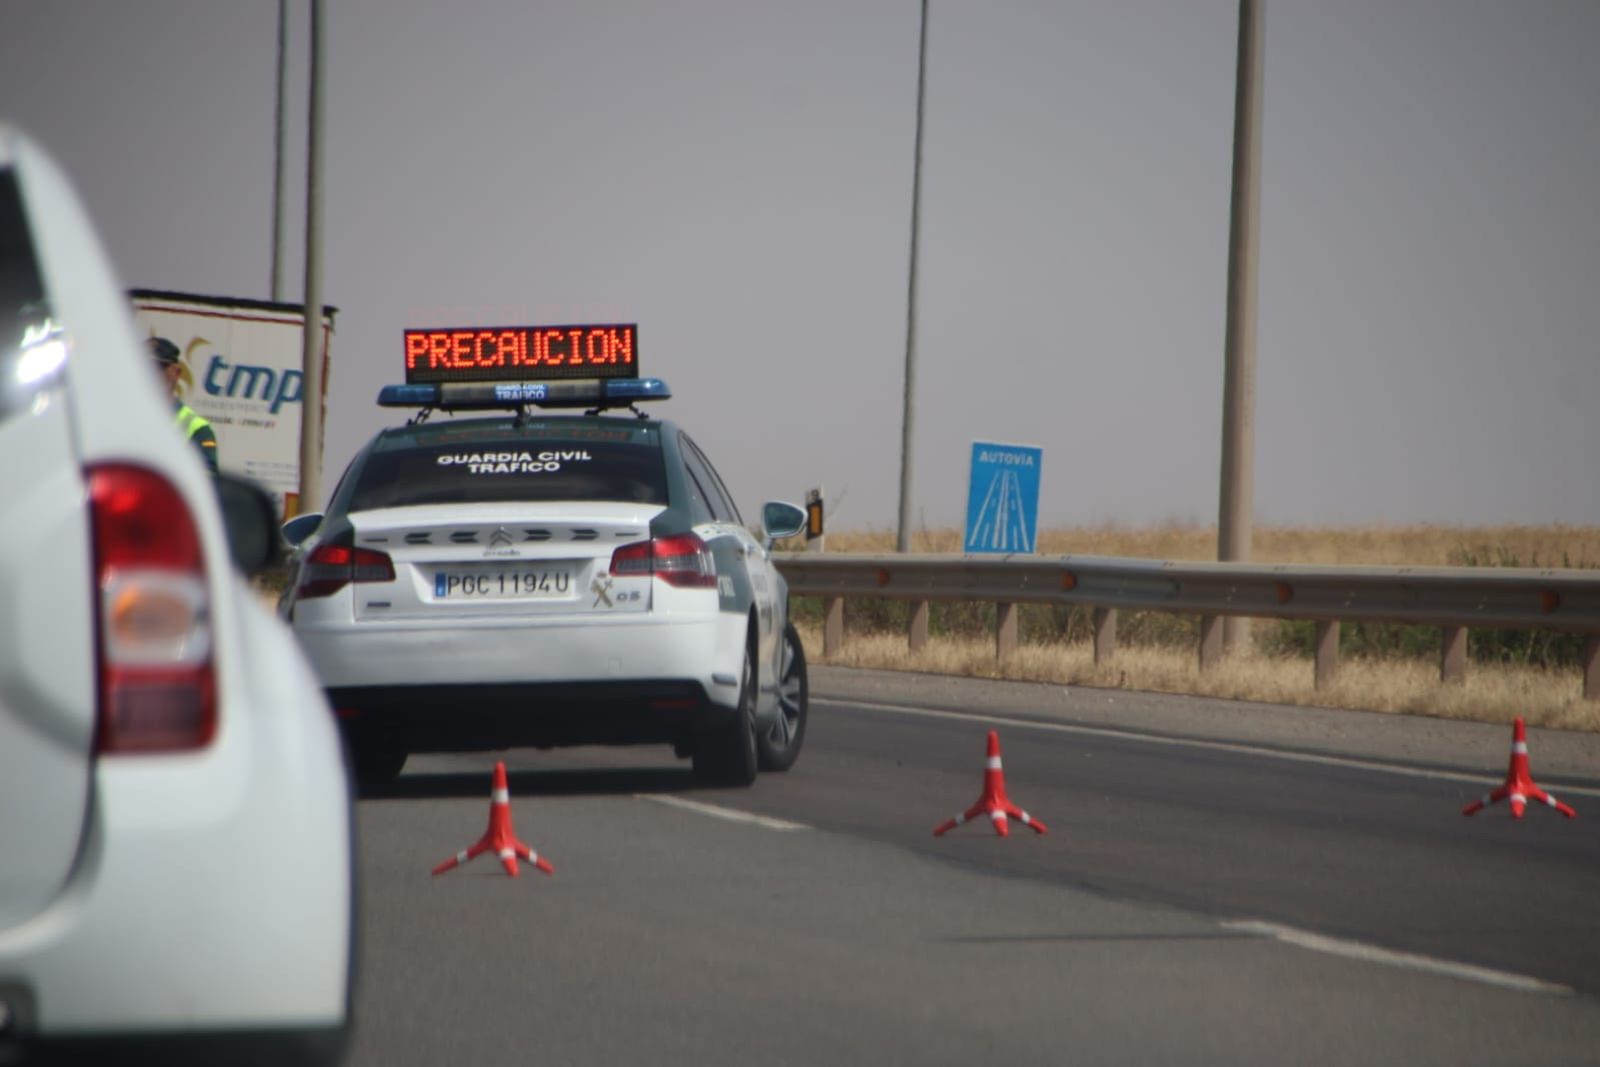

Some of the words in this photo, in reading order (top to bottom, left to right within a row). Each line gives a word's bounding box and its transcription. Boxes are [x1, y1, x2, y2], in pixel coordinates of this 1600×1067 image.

[406, 329, 633, 368] PRECAUCION
[203, 354, 303, 414] tmp
[437, 452, 532, 465] GUARDIA
[538, 451, 592, 461] CIVIL
[468, 461, 561, 473] TRAFICO
